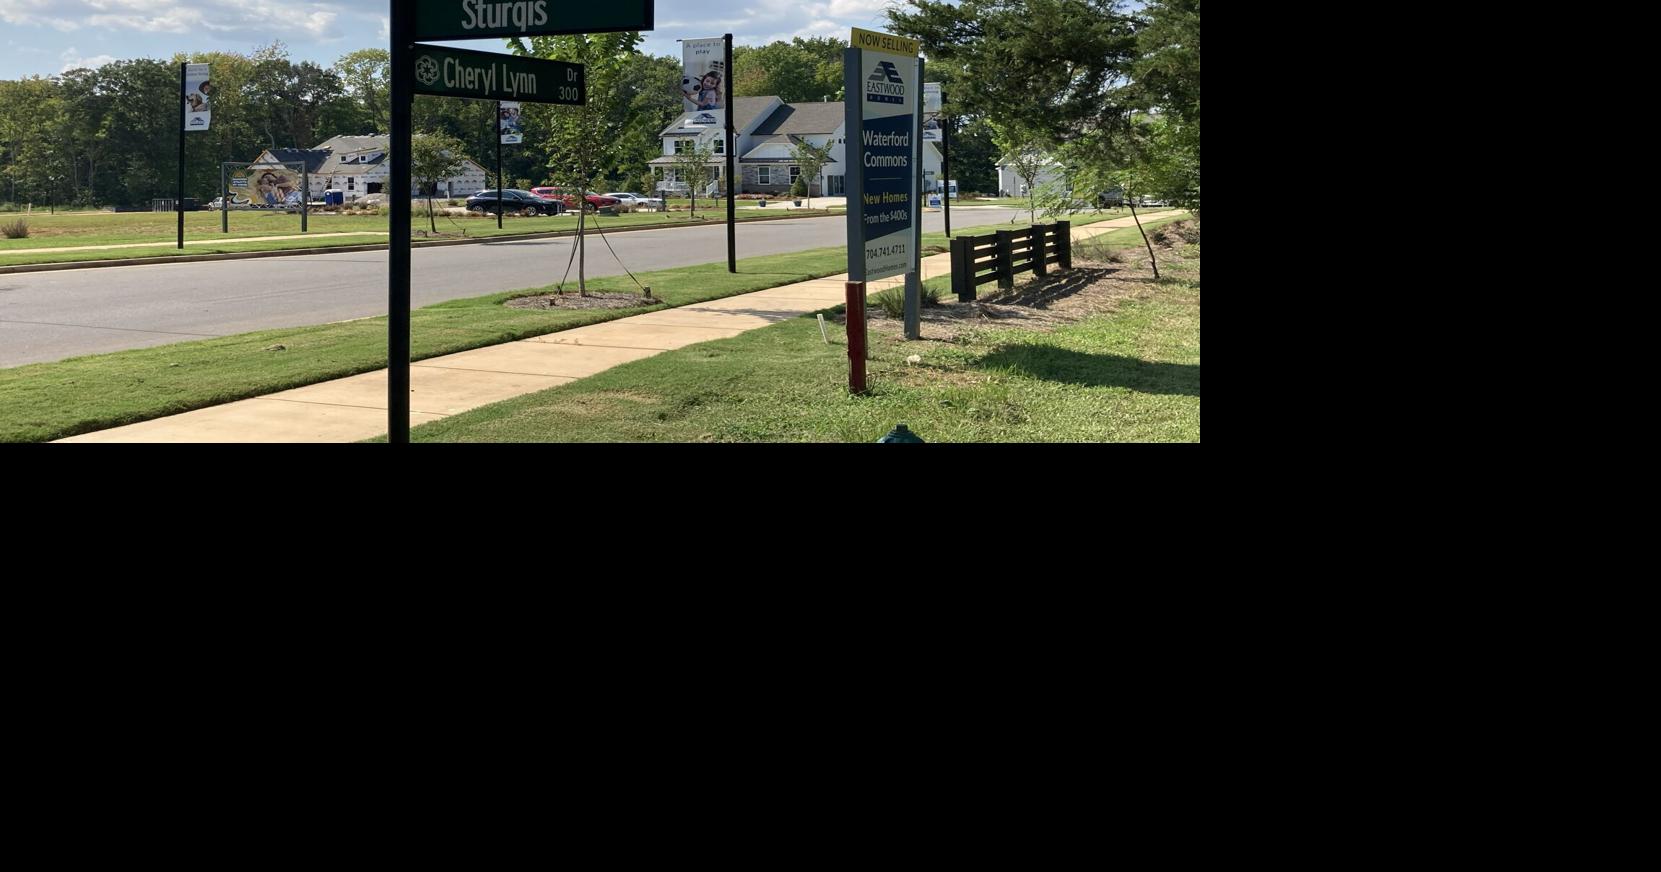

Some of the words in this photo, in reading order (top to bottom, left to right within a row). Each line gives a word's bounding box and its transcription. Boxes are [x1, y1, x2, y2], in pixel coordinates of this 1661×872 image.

[461, 0, 548, 32] Sturgis
[859, 32, 880, 47] NOW
[882, 37, 914, 54] SELLING
[443, 57, 497, 95] Cheryl
[503, 63, 537, 97] Lynn
[567, 67, 578, 83] Dr
[559, 86, 579, 101] 300
[866, 81, 904, 95] EASTWOOD
[862, 130, 909, 147] Waterford
[863, 151, 908, 168] Commons
[863, 192, 881, 205] New
[882, 191, 909, 203] Homes
[863, 213, 879, 224] From
[880, 212, 889, 222] the
[890, 209, 907, 221] $400s
[866, 244, 906, 260] 704.741.4711
